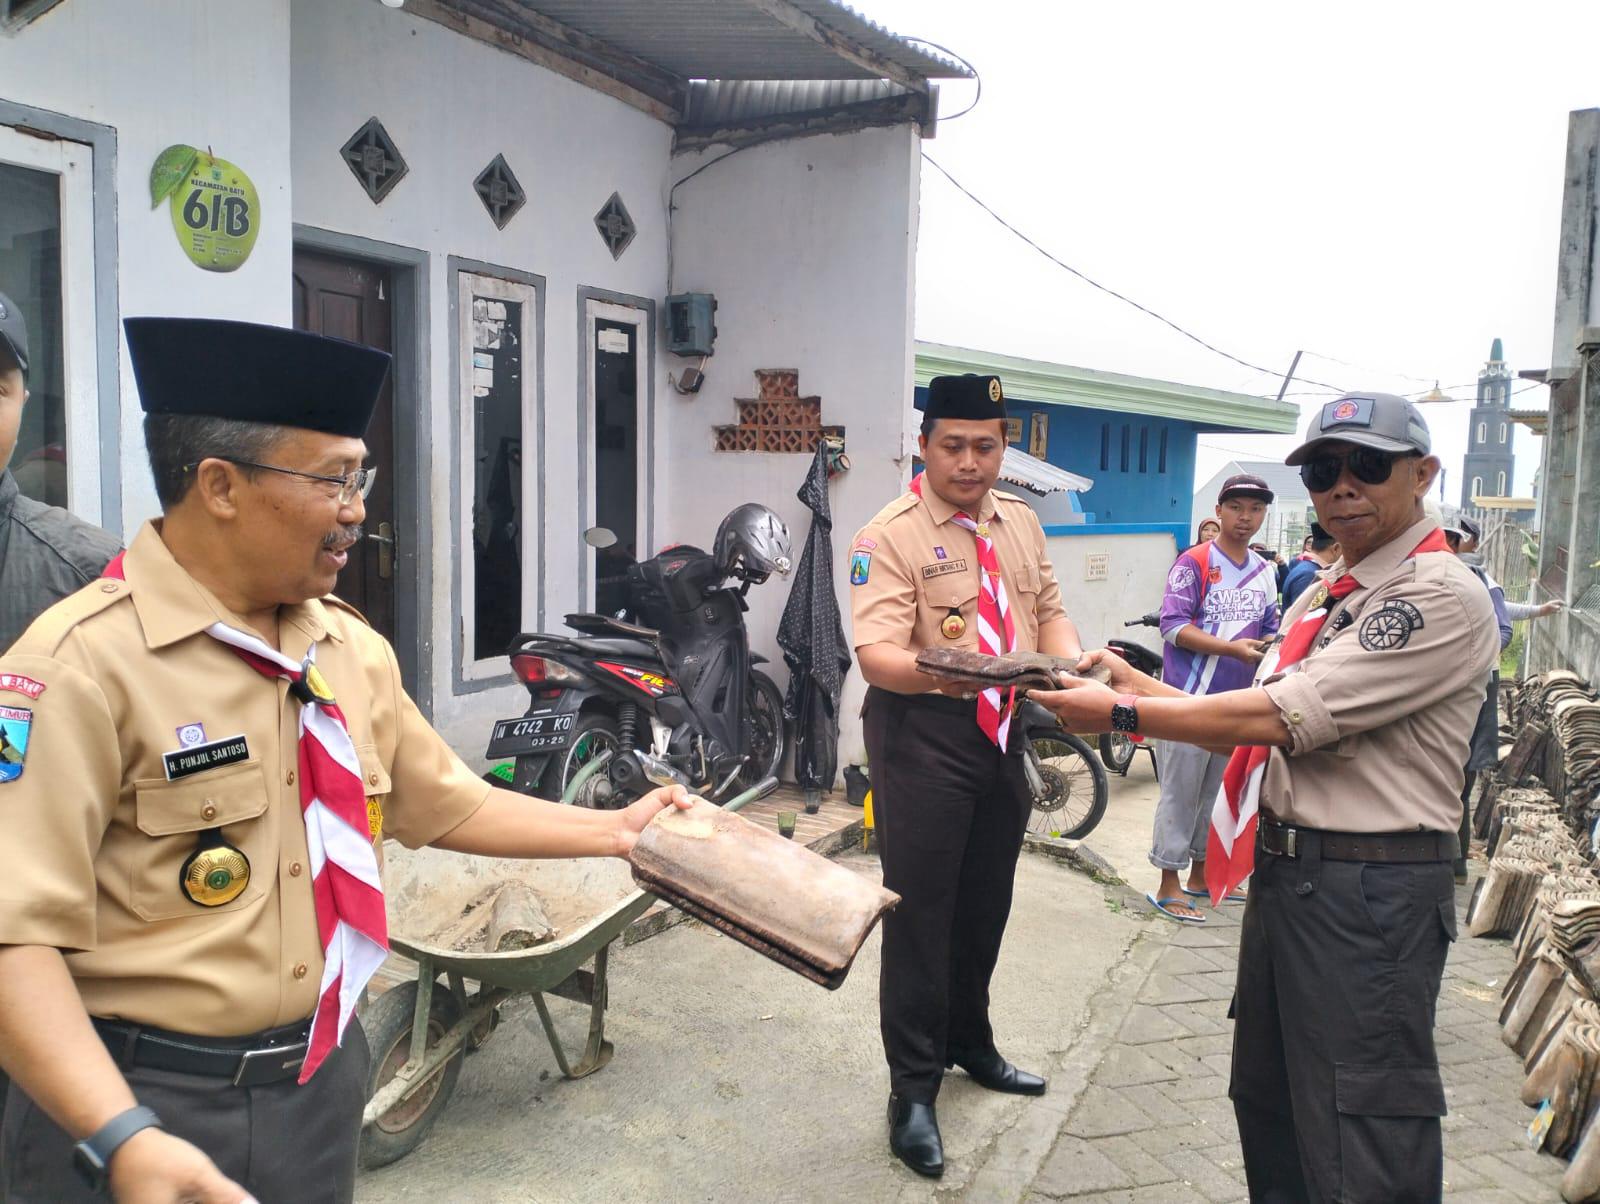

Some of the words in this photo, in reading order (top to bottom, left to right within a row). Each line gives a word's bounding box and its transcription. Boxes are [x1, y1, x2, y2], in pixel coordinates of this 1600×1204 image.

[1204, 611, 1259, 623] ADVENTURE
[497, 726, 506, 739] N
[513, 720, 543, 736] 4742
[169, 761, 179, 772] H.
[180, 752, 210, 769] PUNJUL
[211, 743, 246, 760] SANTOSO
